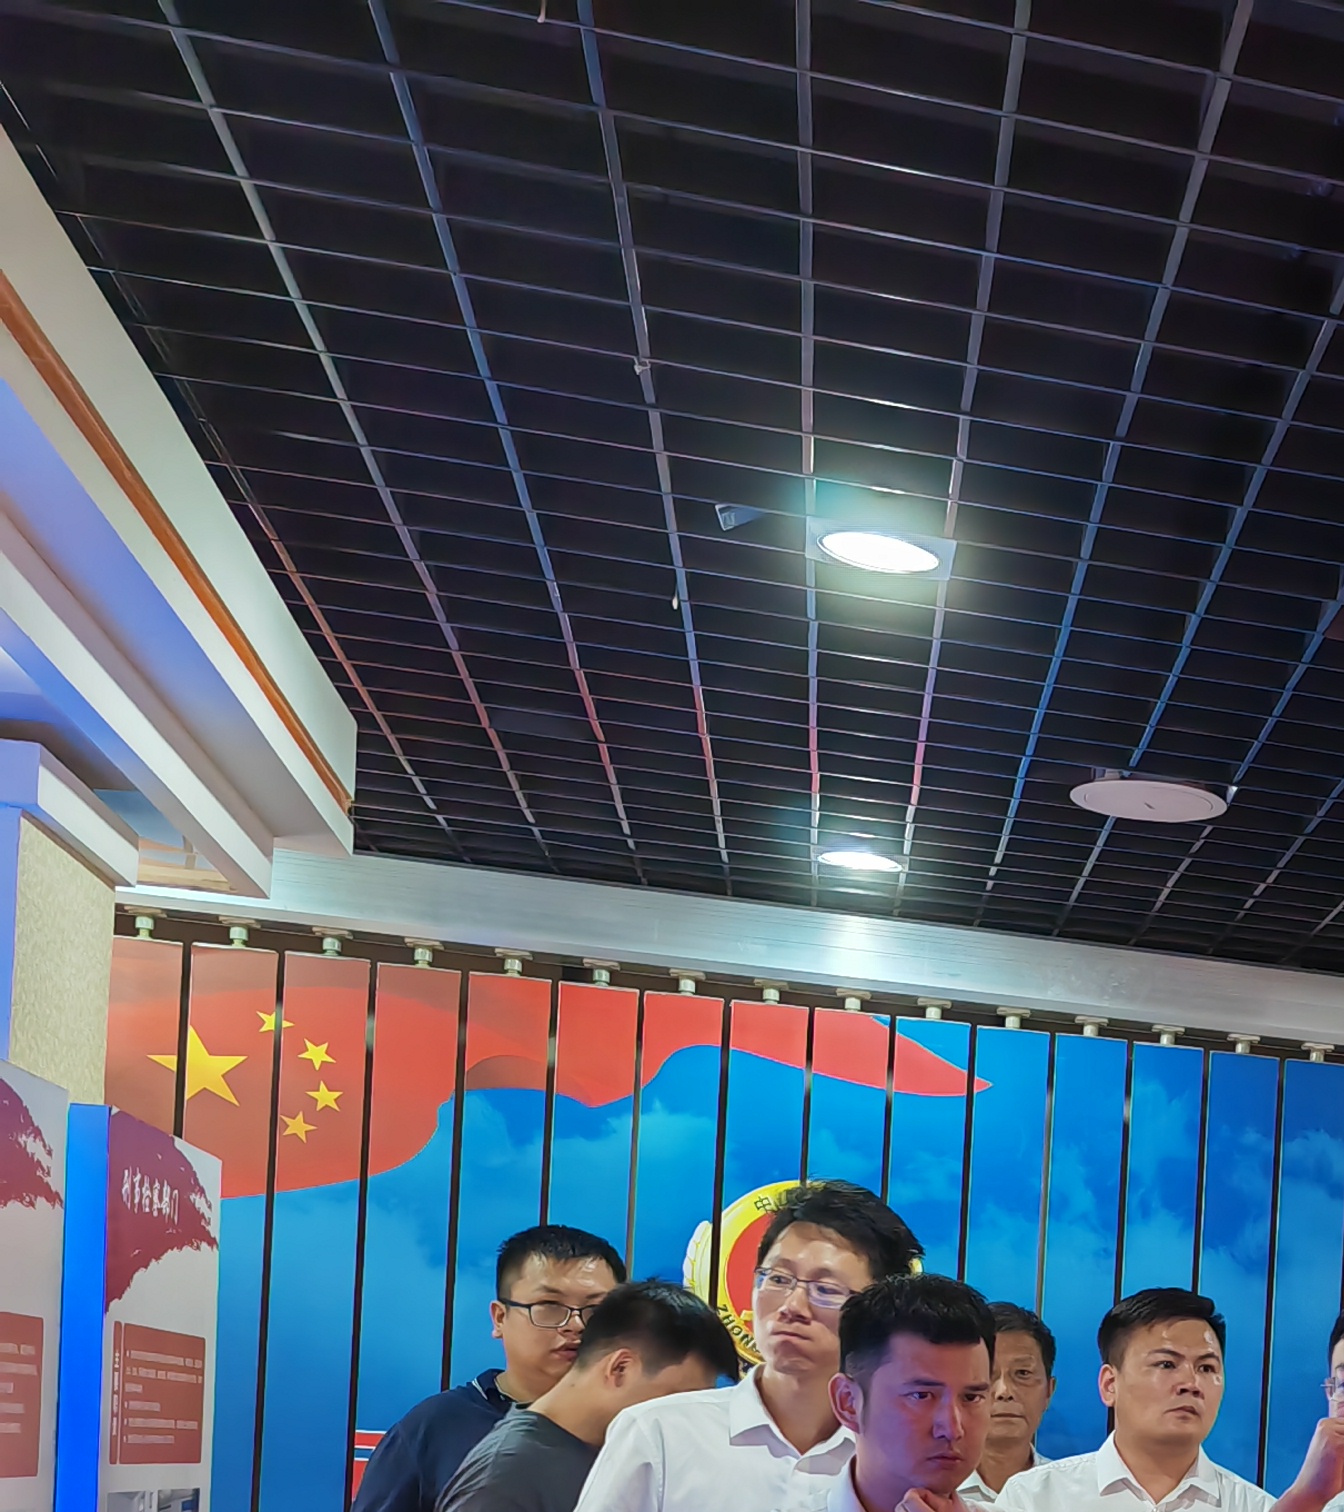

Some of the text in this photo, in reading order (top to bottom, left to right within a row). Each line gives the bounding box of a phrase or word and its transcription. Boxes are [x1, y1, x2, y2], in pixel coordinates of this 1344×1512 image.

[121, 1166, 180, 1227] 刑事检察部门
